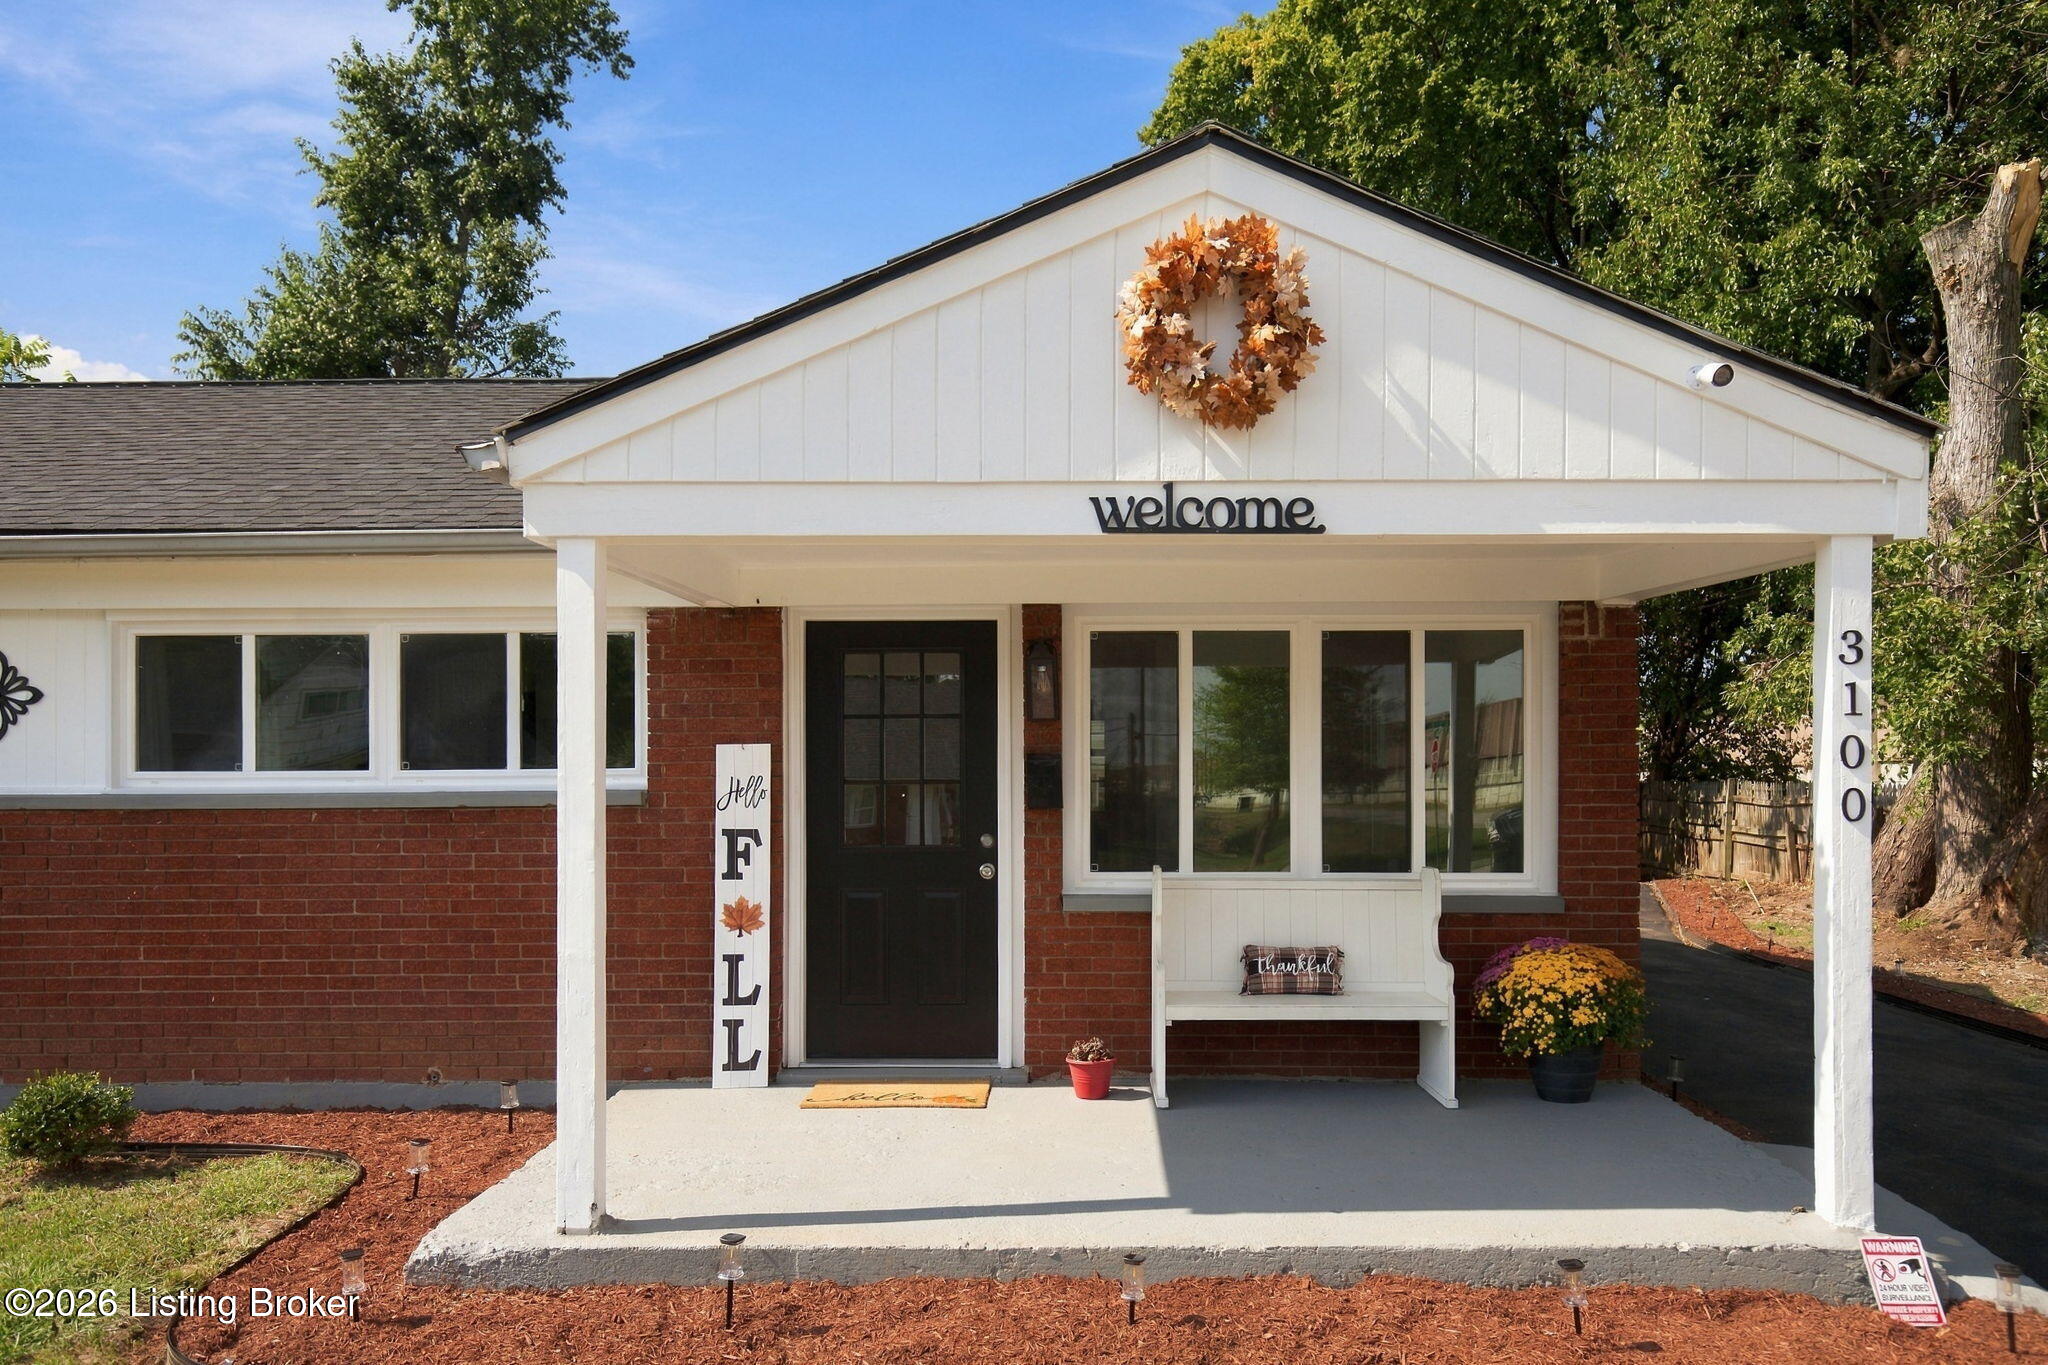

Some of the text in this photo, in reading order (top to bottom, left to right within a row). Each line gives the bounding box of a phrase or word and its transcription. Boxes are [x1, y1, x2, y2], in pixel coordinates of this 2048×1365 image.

[1089, 482, 1326, 534] welcome
[1839, 630, 1866, 822] 3100
[717, 775, 767, 811] Hello
[1253, 953, 1335, 981] thankful
[1863, 1241, 1920, 1253] WARNING
[1888, 1284, 1907, 1292] HOUR
[1909, 1284, 1930, 1292] VIDEO
